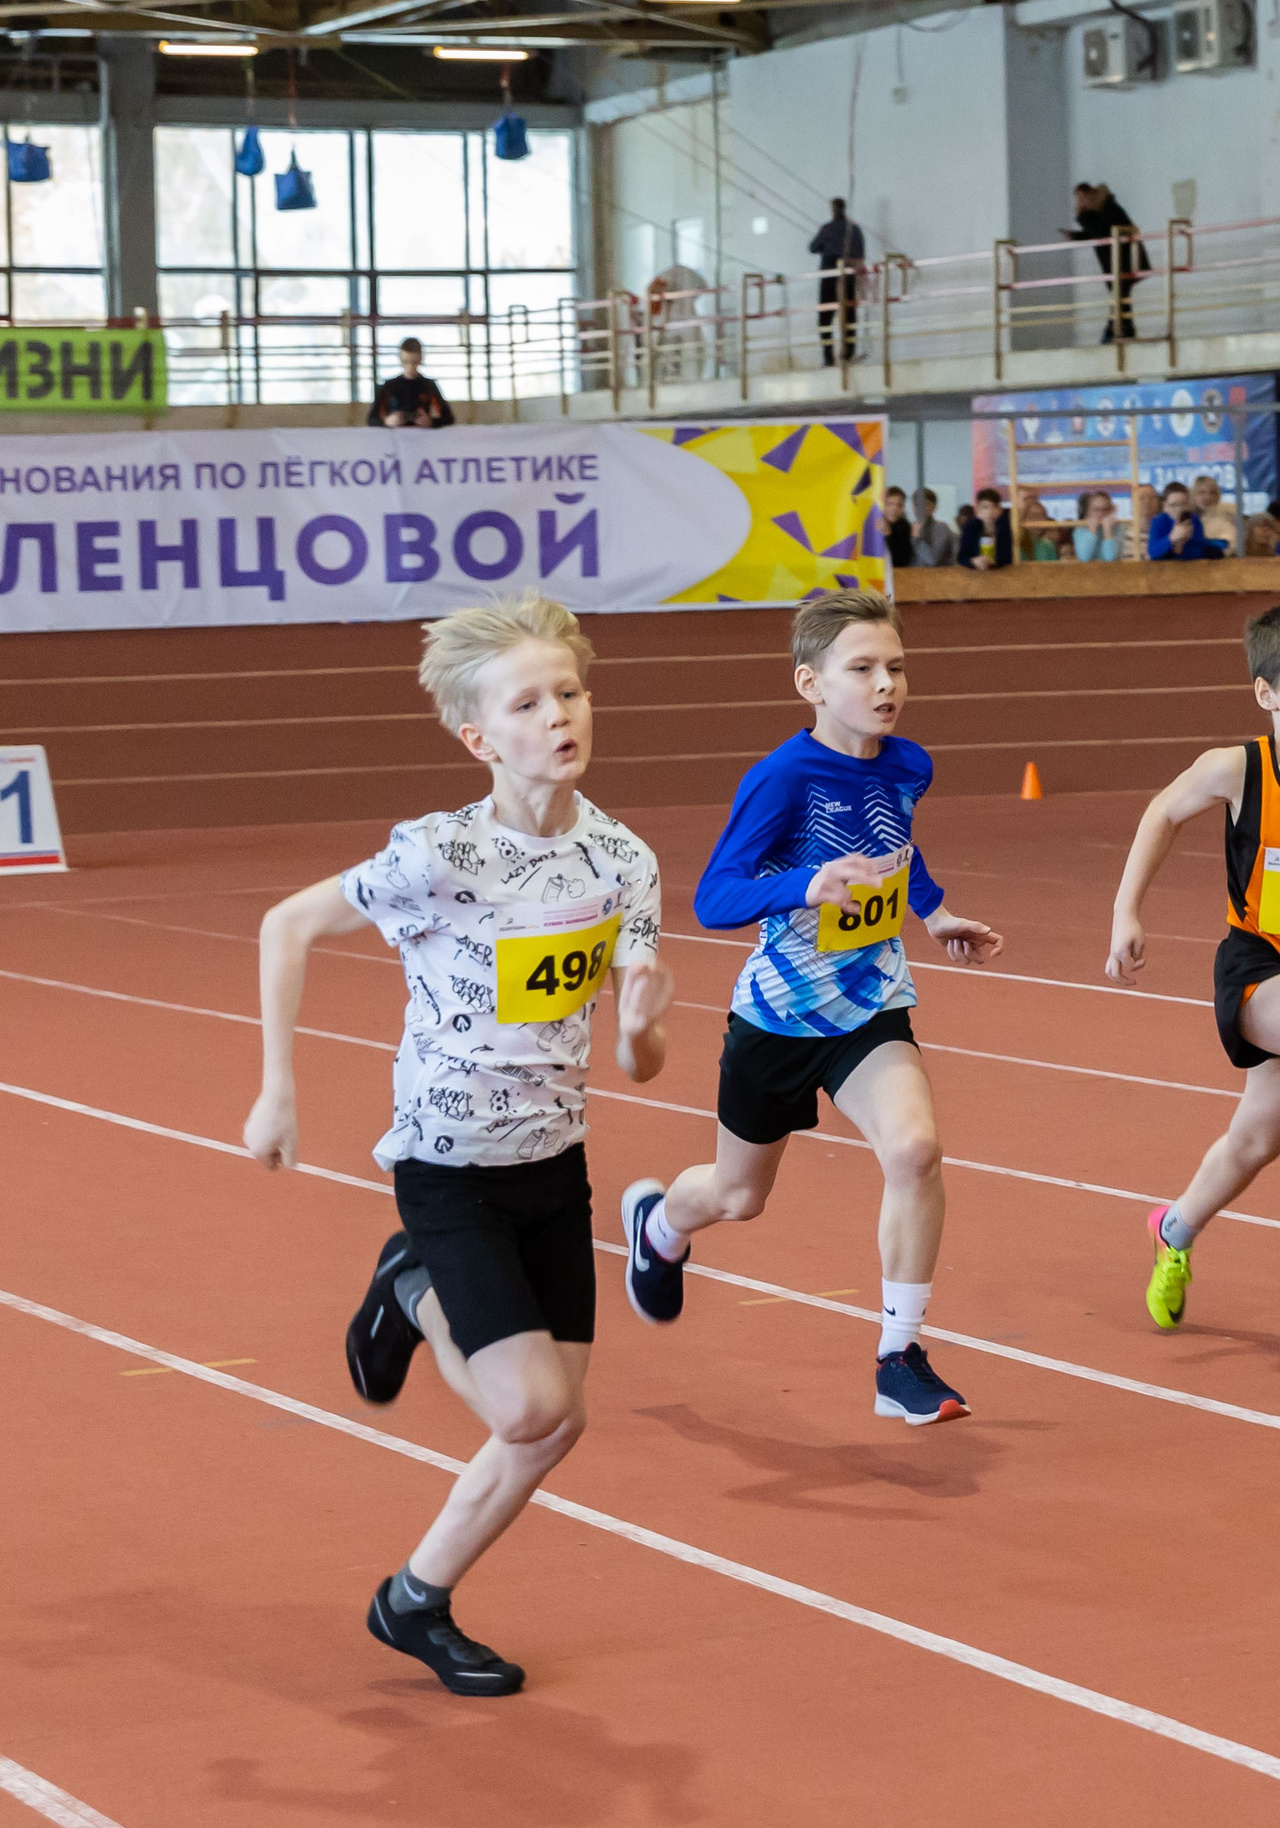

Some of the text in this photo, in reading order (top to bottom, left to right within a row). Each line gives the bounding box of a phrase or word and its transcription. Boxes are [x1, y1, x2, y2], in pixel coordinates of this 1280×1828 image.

[0, 454, 599, 493] НОВАНИЯ ПО ЛЁГКОЙ АТЛЕТИКЕ
[0, 491, 599, 602] ЛЕНЦОВОЙ
[0, 770, 34, 844] 1
[501, 864, 528, 885] LAZY
[838, 888, 899, 932] 801
[526, 940, 607, 996] 498
